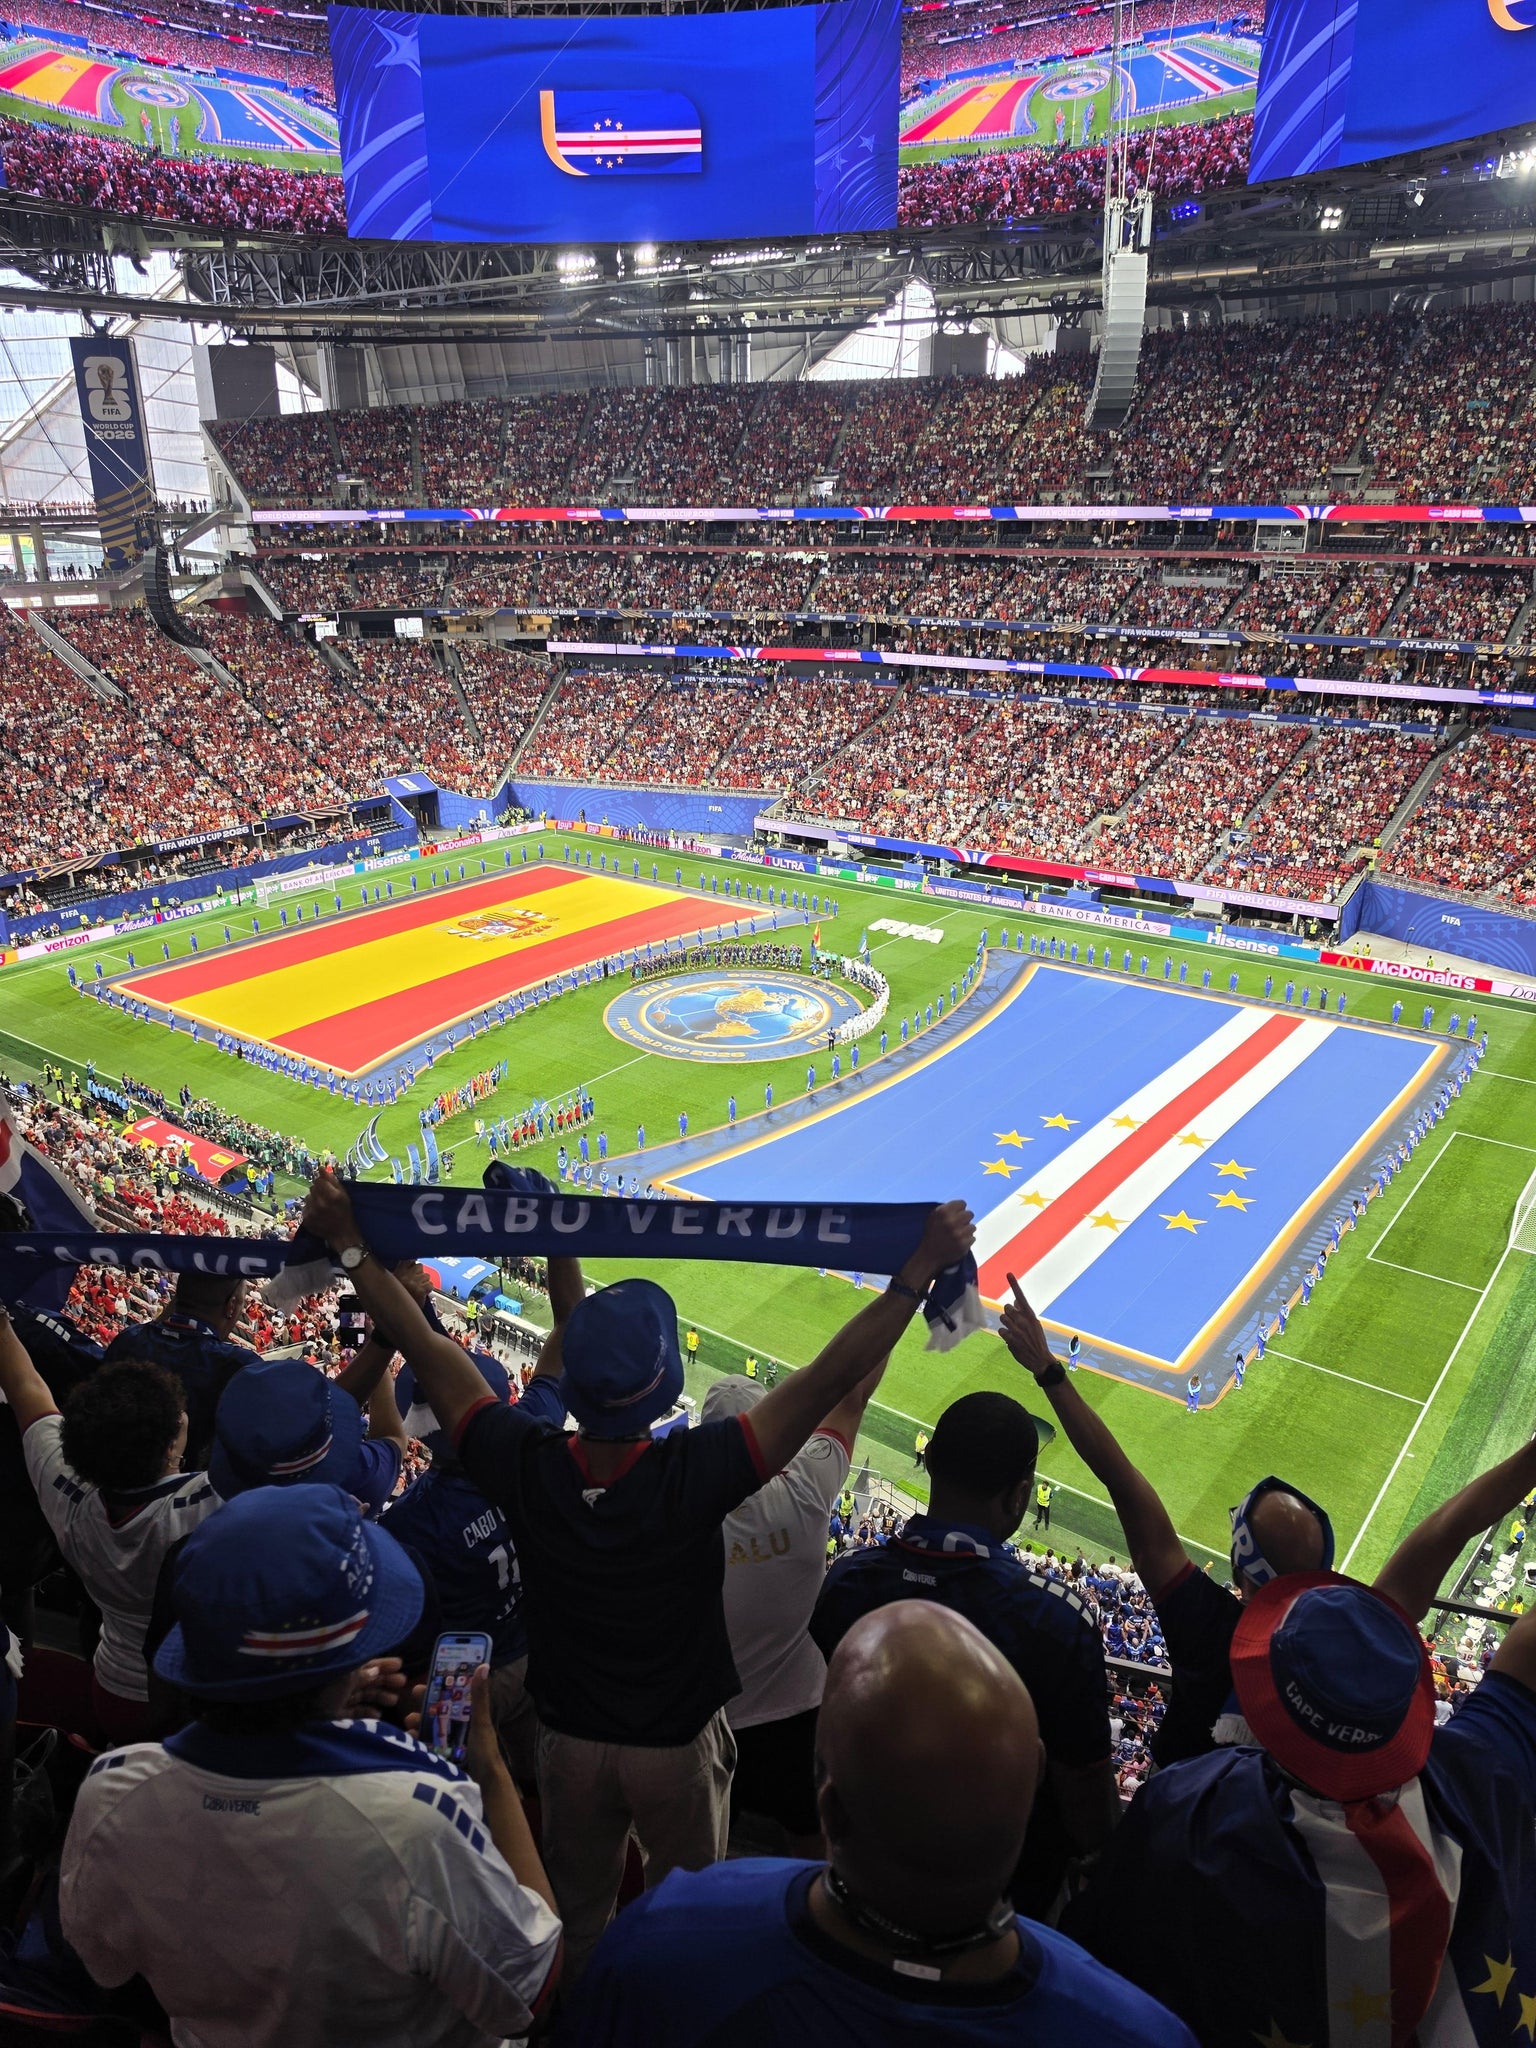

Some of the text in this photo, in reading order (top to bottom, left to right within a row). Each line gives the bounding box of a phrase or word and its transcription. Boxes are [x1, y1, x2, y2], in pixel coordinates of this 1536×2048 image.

[102, 408, 122, 416] FIFA
[94, 430, 136, 440] 2026
[919, 619, 961, 627] ATLANTA
[1133, 629, 1160, 637] WORLD
[1160, 630, 1175, 638] CUP
[1398, 640, 1460, 650] ATLANTA
[1335, 684, 1368, 692] WORLD
[1387, 688, 1421, 696] 2026
[708, 805, 723, 813] FIFA
[158, 826, 250, 852] FIFA WORLD CUP 2026
[366, 838, 381, 847] FIFA
[364, 852, 411, 871] Hisense
[731, 850, 806, 872] Michelob ULTRA
[935, 887, 1023, 909] UNITED STATES OF AMERICA
[1206, 890, 1325, 915] FIFA WORLD CUP 2026
[60, 909, 80, 920] FIFA
[115, 904, 202, 935] Michelob ULTRA
[1040, 904, 1150, 931] BANK OF AMERICA
[1441, 914, 1461, 926] FIFA
[44, 934, 90, 953] verizon
[1206, 931, 1280, 956] Hisense
[1370, 960, 1476, 990] McDonald's
[662, 1044, 690, 1053] CUP
[689, 1050, 747, 1058] 2026
[411, 1192, 851, 1244] CABO VERDE
[462, 1509, 498, 1549] CABO
[728, 1528, 791, 1568] ALU
[1285, 1680, 1324, 1728] CAPE
